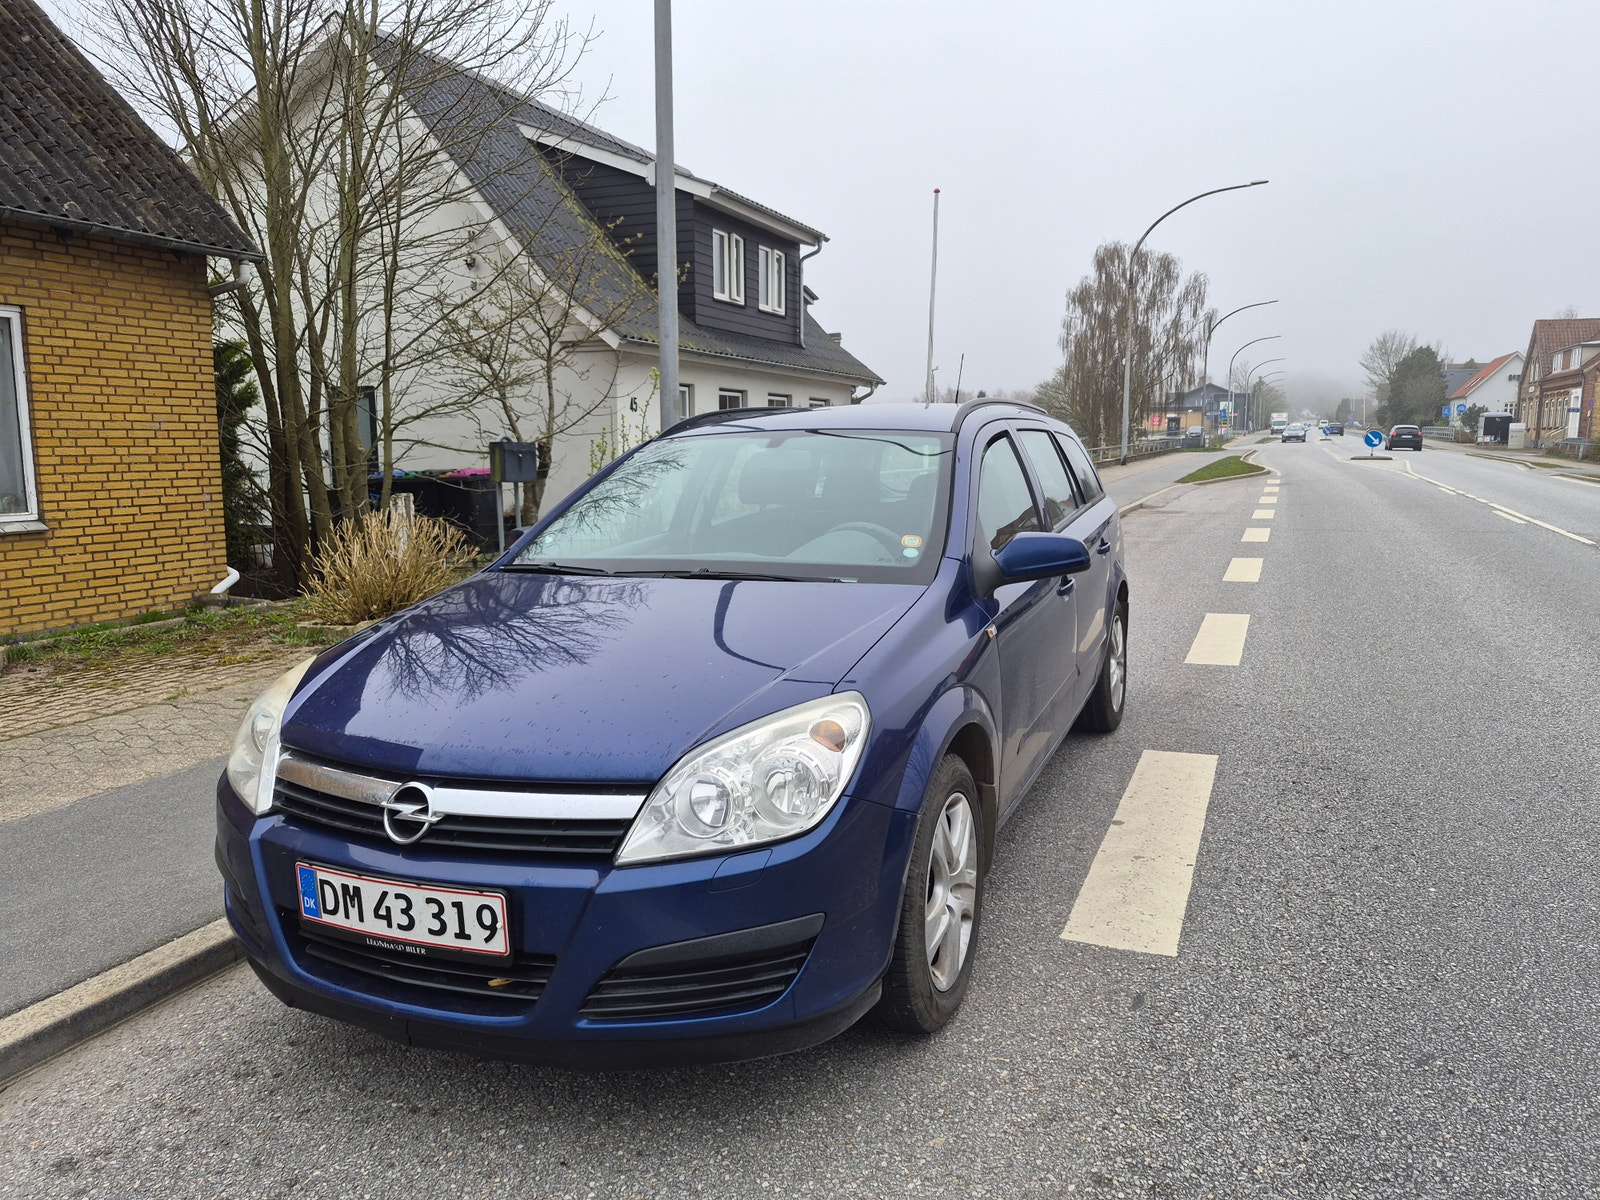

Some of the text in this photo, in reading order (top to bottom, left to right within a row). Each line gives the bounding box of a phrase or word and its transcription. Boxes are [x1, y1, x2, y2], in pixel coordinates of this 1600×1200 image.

[629, 396, 638, 413] 45
[304, 897, 316, 910] DK
[319, 878, 498, 944] DM 43 319
[405, 945, 426, 955] BILER
